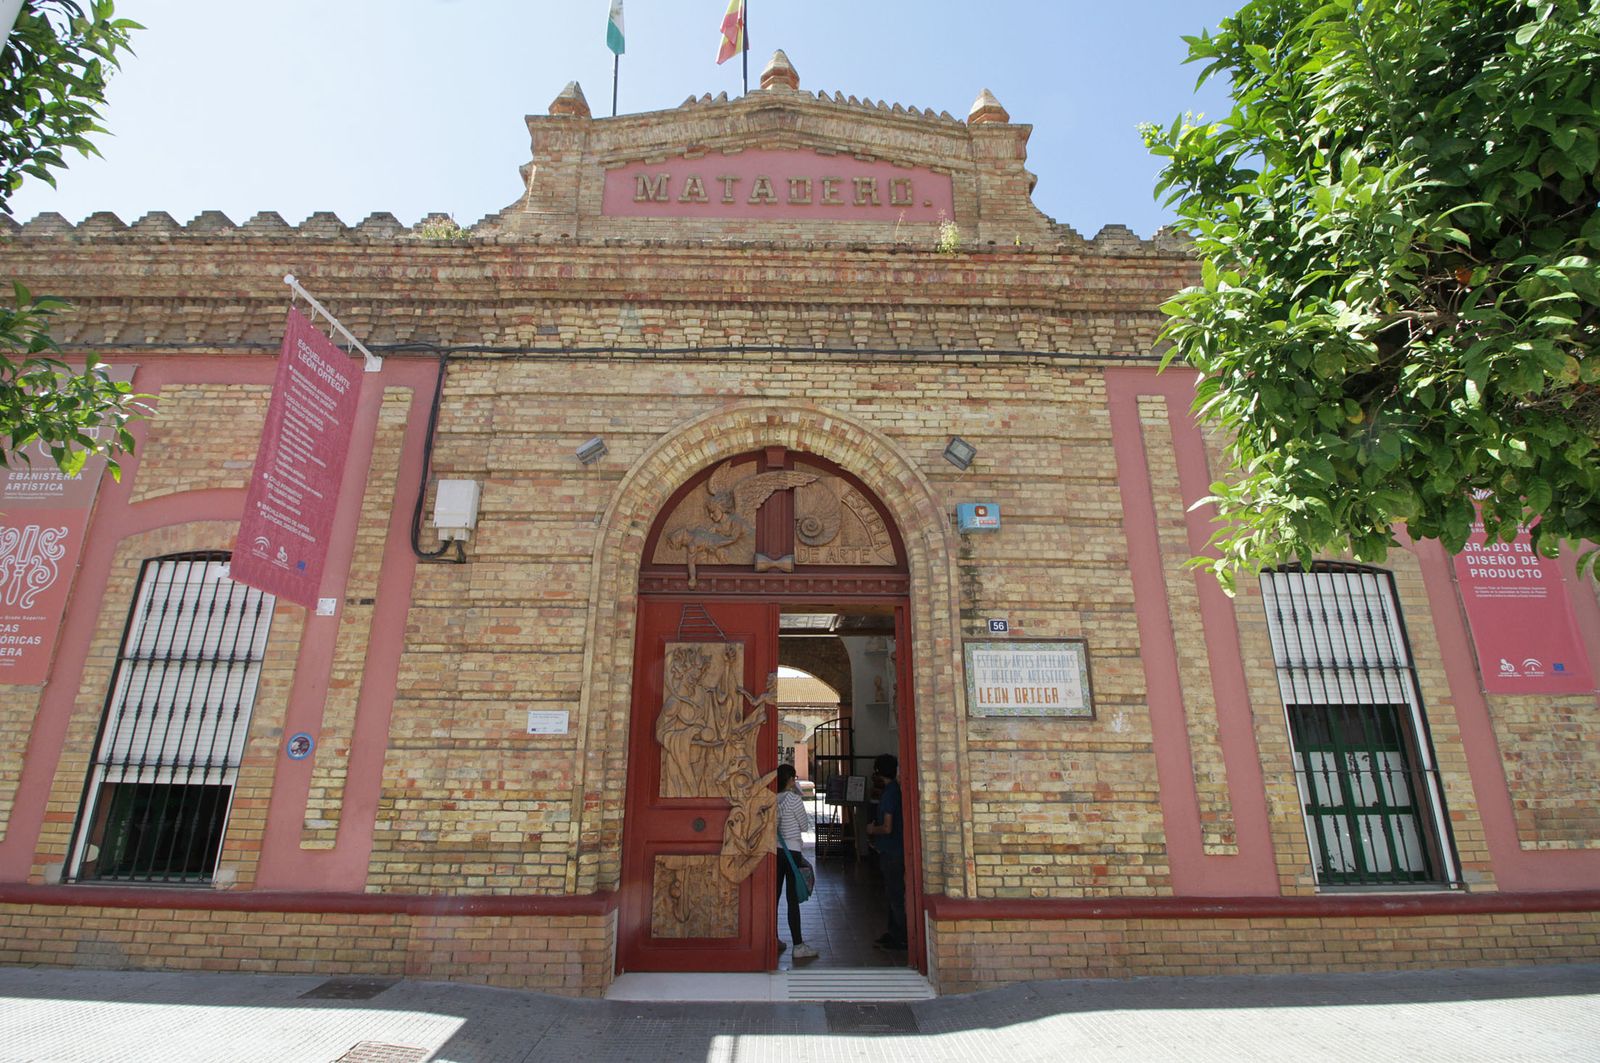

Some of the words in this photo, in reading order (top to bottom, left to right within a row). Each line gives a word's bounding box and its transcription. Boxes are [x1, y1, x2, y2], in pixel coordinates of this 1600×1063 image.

[297, 338, 324, 367] ESCUELA
[326, 364, 334, 375] DE
[335, 372, 350, 389] ARTE
[317, 367, 344, 394] ORTEGA
[5, 481, 64, 491] ARTÍSTICA
[1515, 543, 1532, 552] EN
[798, 548, 820, 564] DE
[825, 547, 871, 564] ARTE
[1466, 553, 1516, 565] DISEÑO
[1520, 556, 1539, 565] DE
[1470, 568, 1542, 578] PRODUCTO
[993, 621, 1004, 630] 56
[976, 654, 1008, 668] ESCUELA
[1012, 654, 1034, 668] ARTES
[982, 670, 988, 684] Y
[991, 670, 1023, 684] OFICIOS
[1014, 687, 1059, 704] ORTEGA
